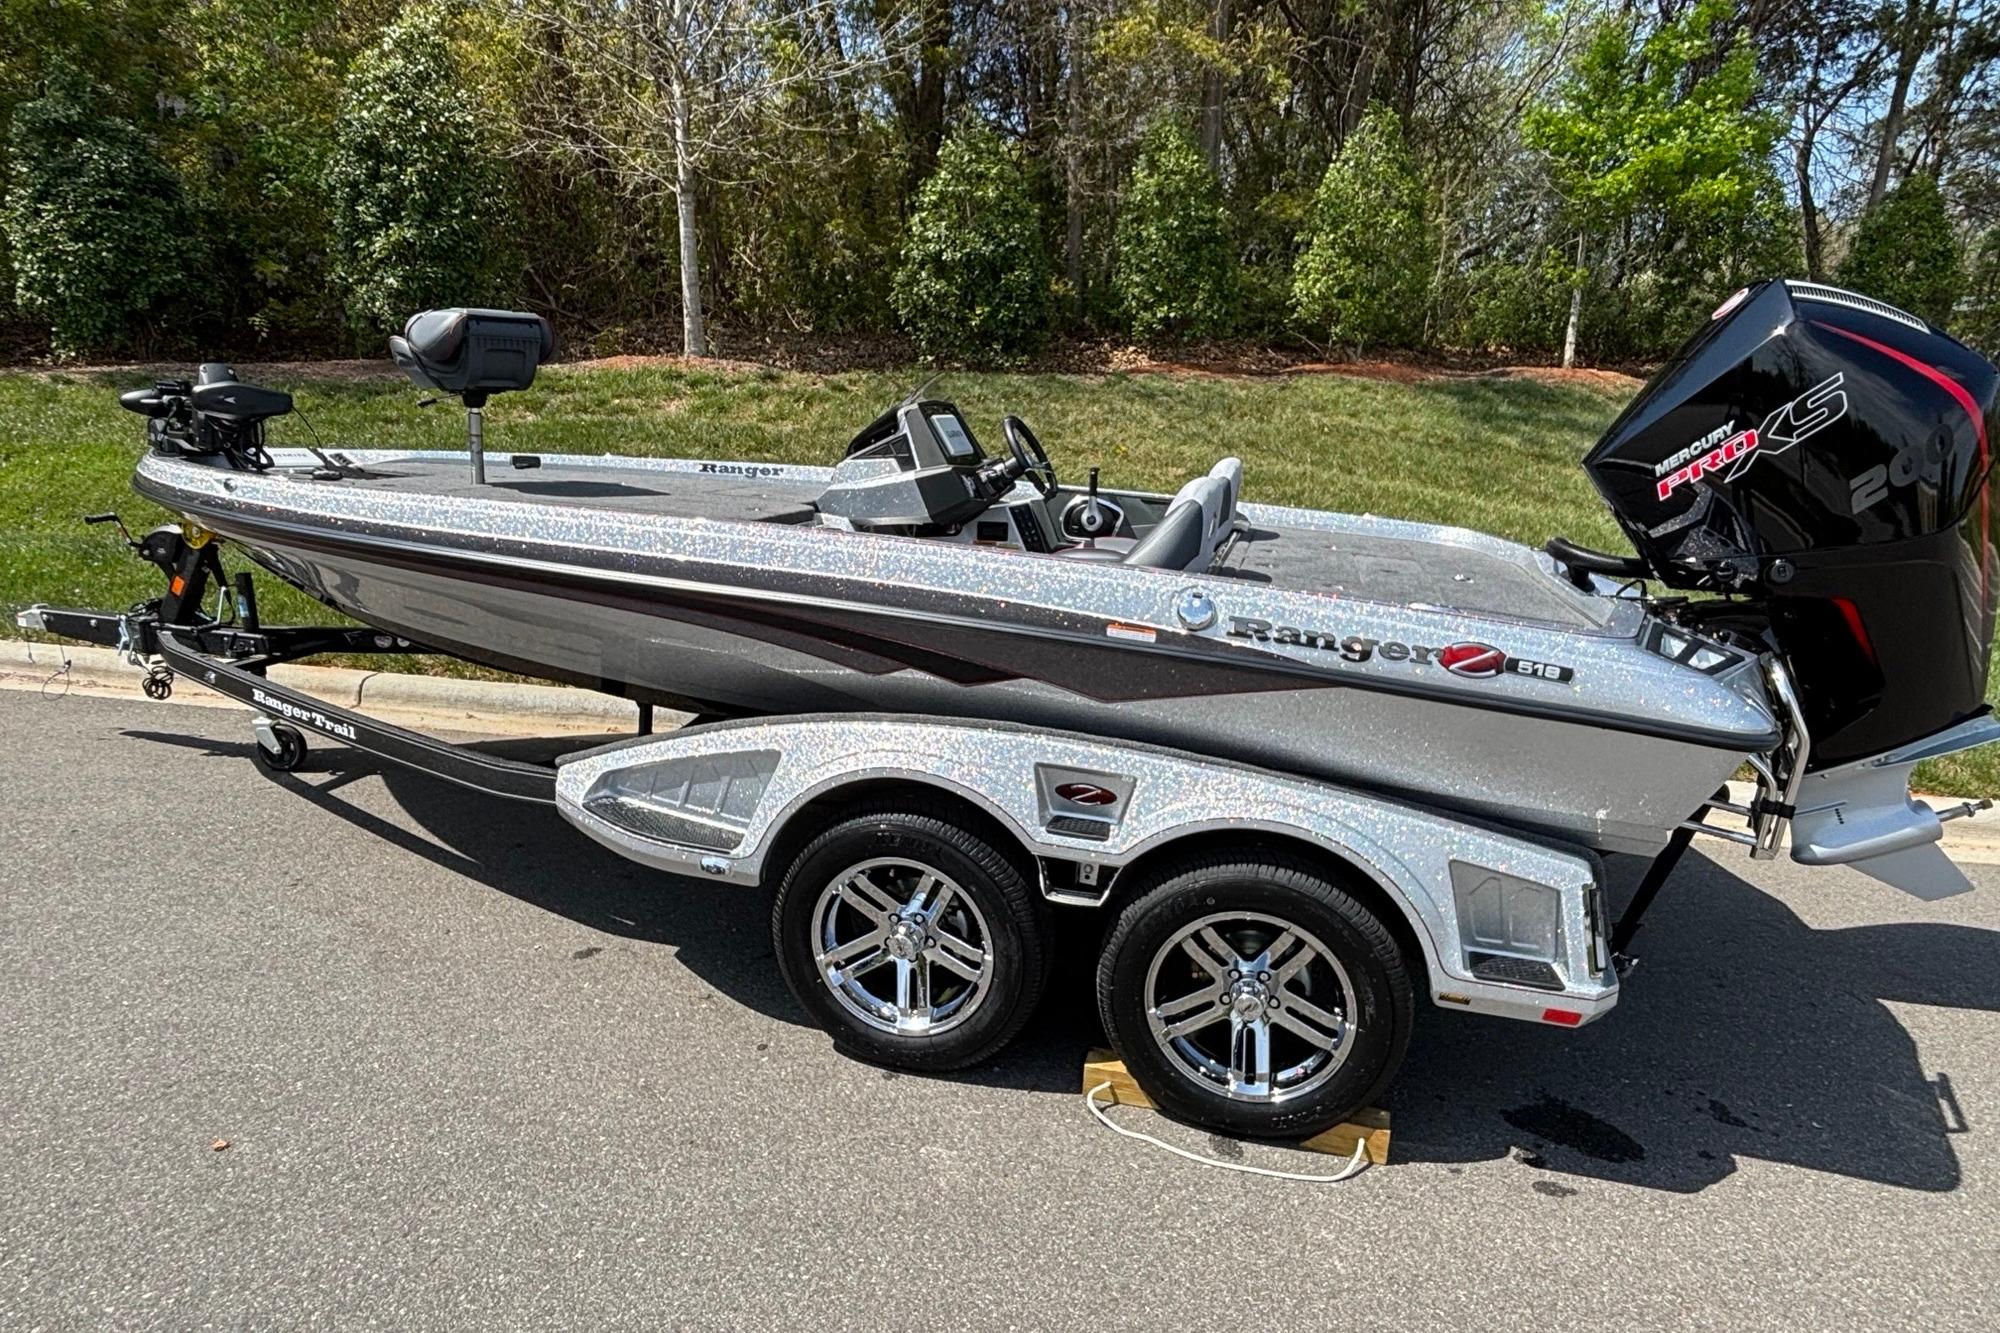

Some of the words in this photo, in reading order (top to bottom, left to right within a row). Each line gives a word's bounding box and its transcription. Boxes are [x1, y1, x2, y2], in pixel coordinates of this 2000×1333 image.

[699, 463, 784, 479] Ranger
[1656, 420, 1735, 477] MERCURY
[1226, 615, 1443, 666] Ranger
[252, 688, 311, 721] Ranger
[311, 712, 357, 740] Trail
